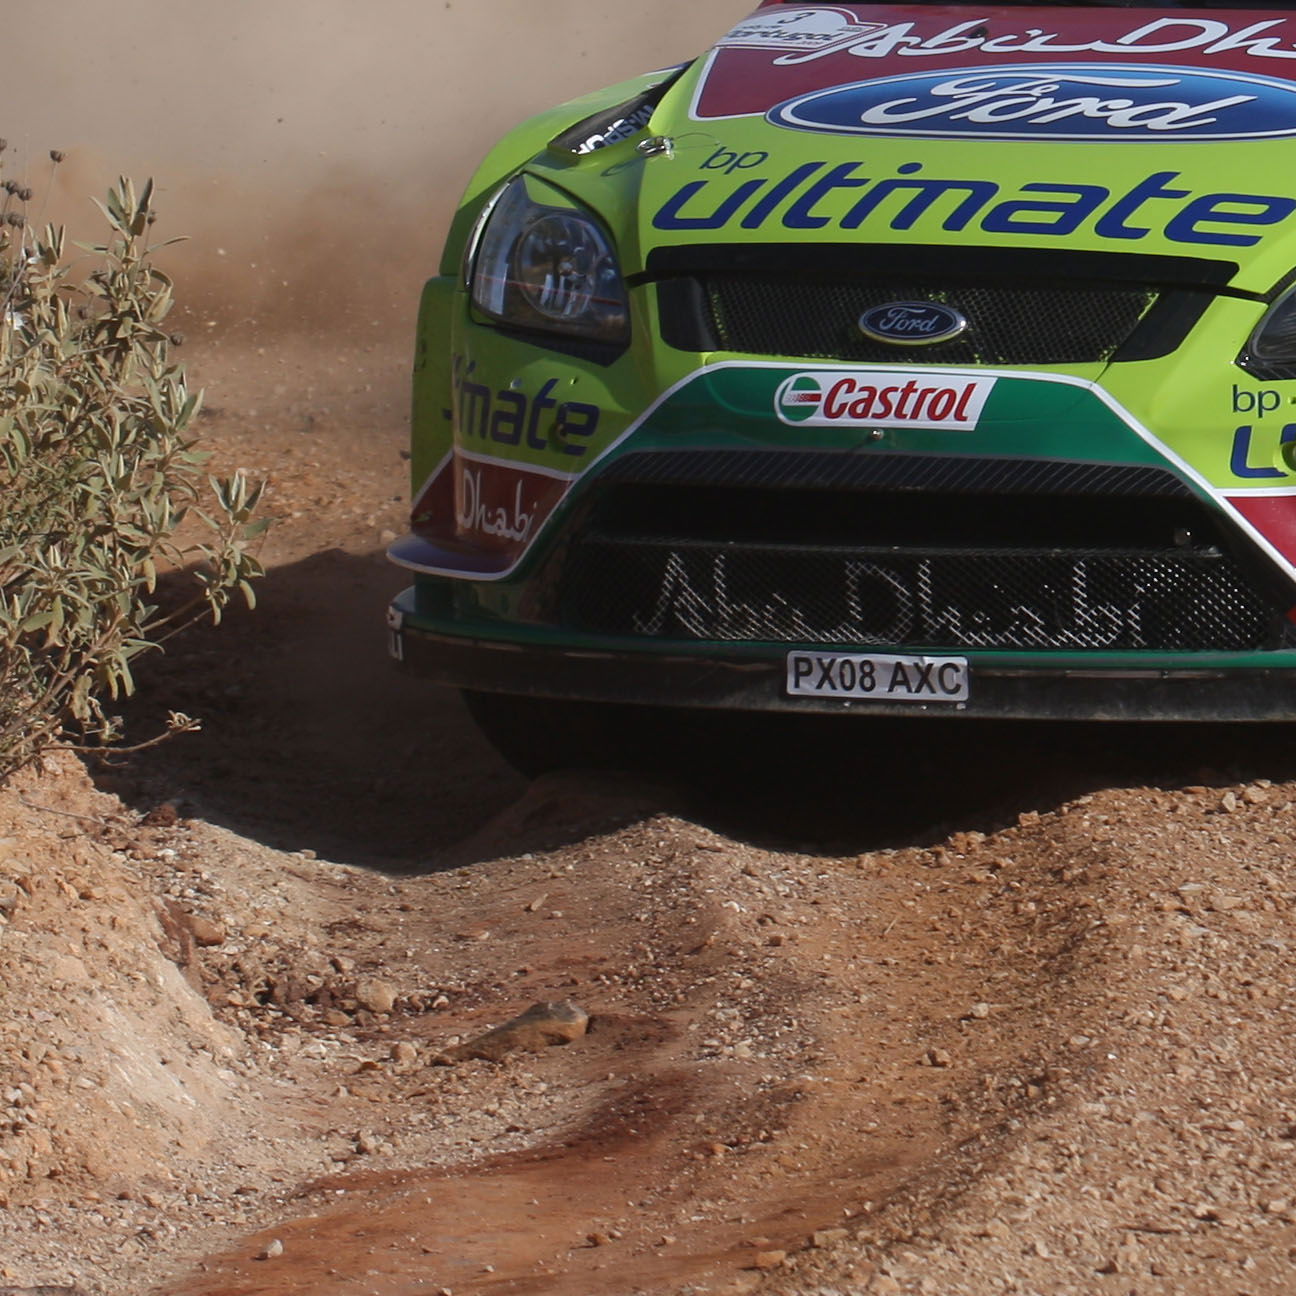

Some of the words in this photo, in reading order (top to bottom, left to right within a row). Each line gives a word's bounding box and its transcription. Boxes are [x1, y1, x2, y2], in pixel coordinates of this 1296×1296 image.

[772, 17, 1112, 66] Abu
[860, 72, 1258, 131] Ford
[699, 147, 768, 173] bp
[879, 307, 940, 332] Ford
[823, 378, 978, 421] Castrol
[1232, 384, 1281, 418] bp
[456, 468, 537, 542] Dhabi
[792, 656, 876, 692] PX08
[888, 661, 963, 695] AXC
